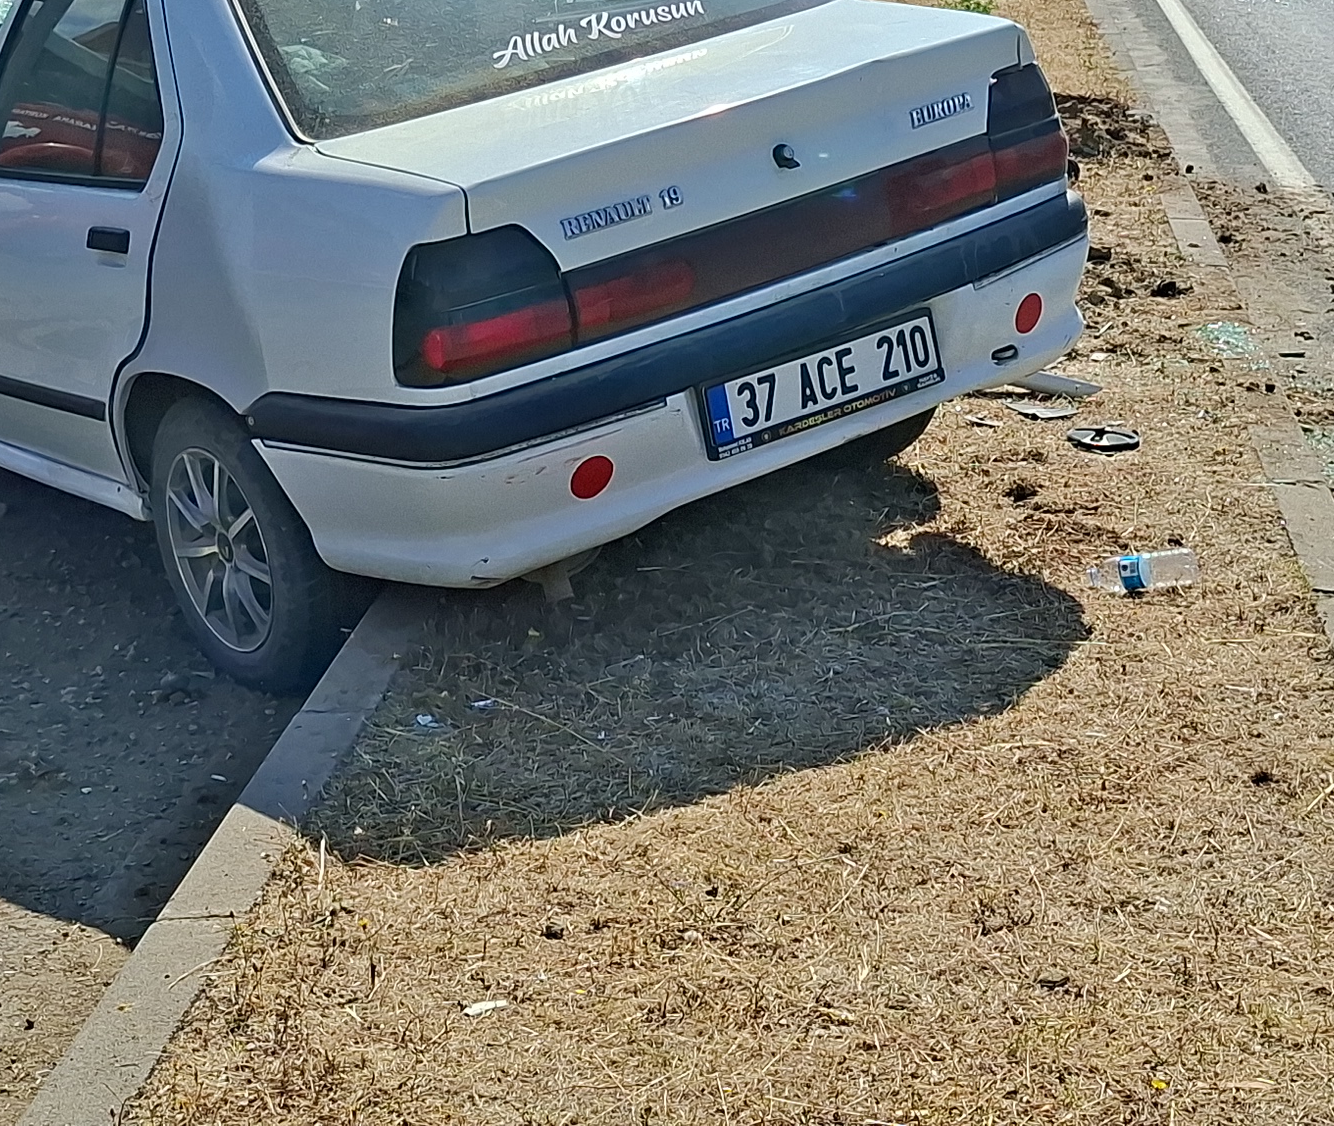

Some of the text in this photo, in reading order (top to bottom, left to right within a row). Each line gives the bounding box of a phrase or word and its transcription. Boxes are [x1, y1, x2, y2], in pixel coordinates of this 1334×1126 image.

[493, 0, 704, 68] Allah Korusun
[909, 92, 975, 129] EUROPA
[560, 185, 683, 240] RENAULT 19
[713, 326, 929, 433] TR 37 ACE 210
[843, 388, 896, 414] OTOMOTİV
